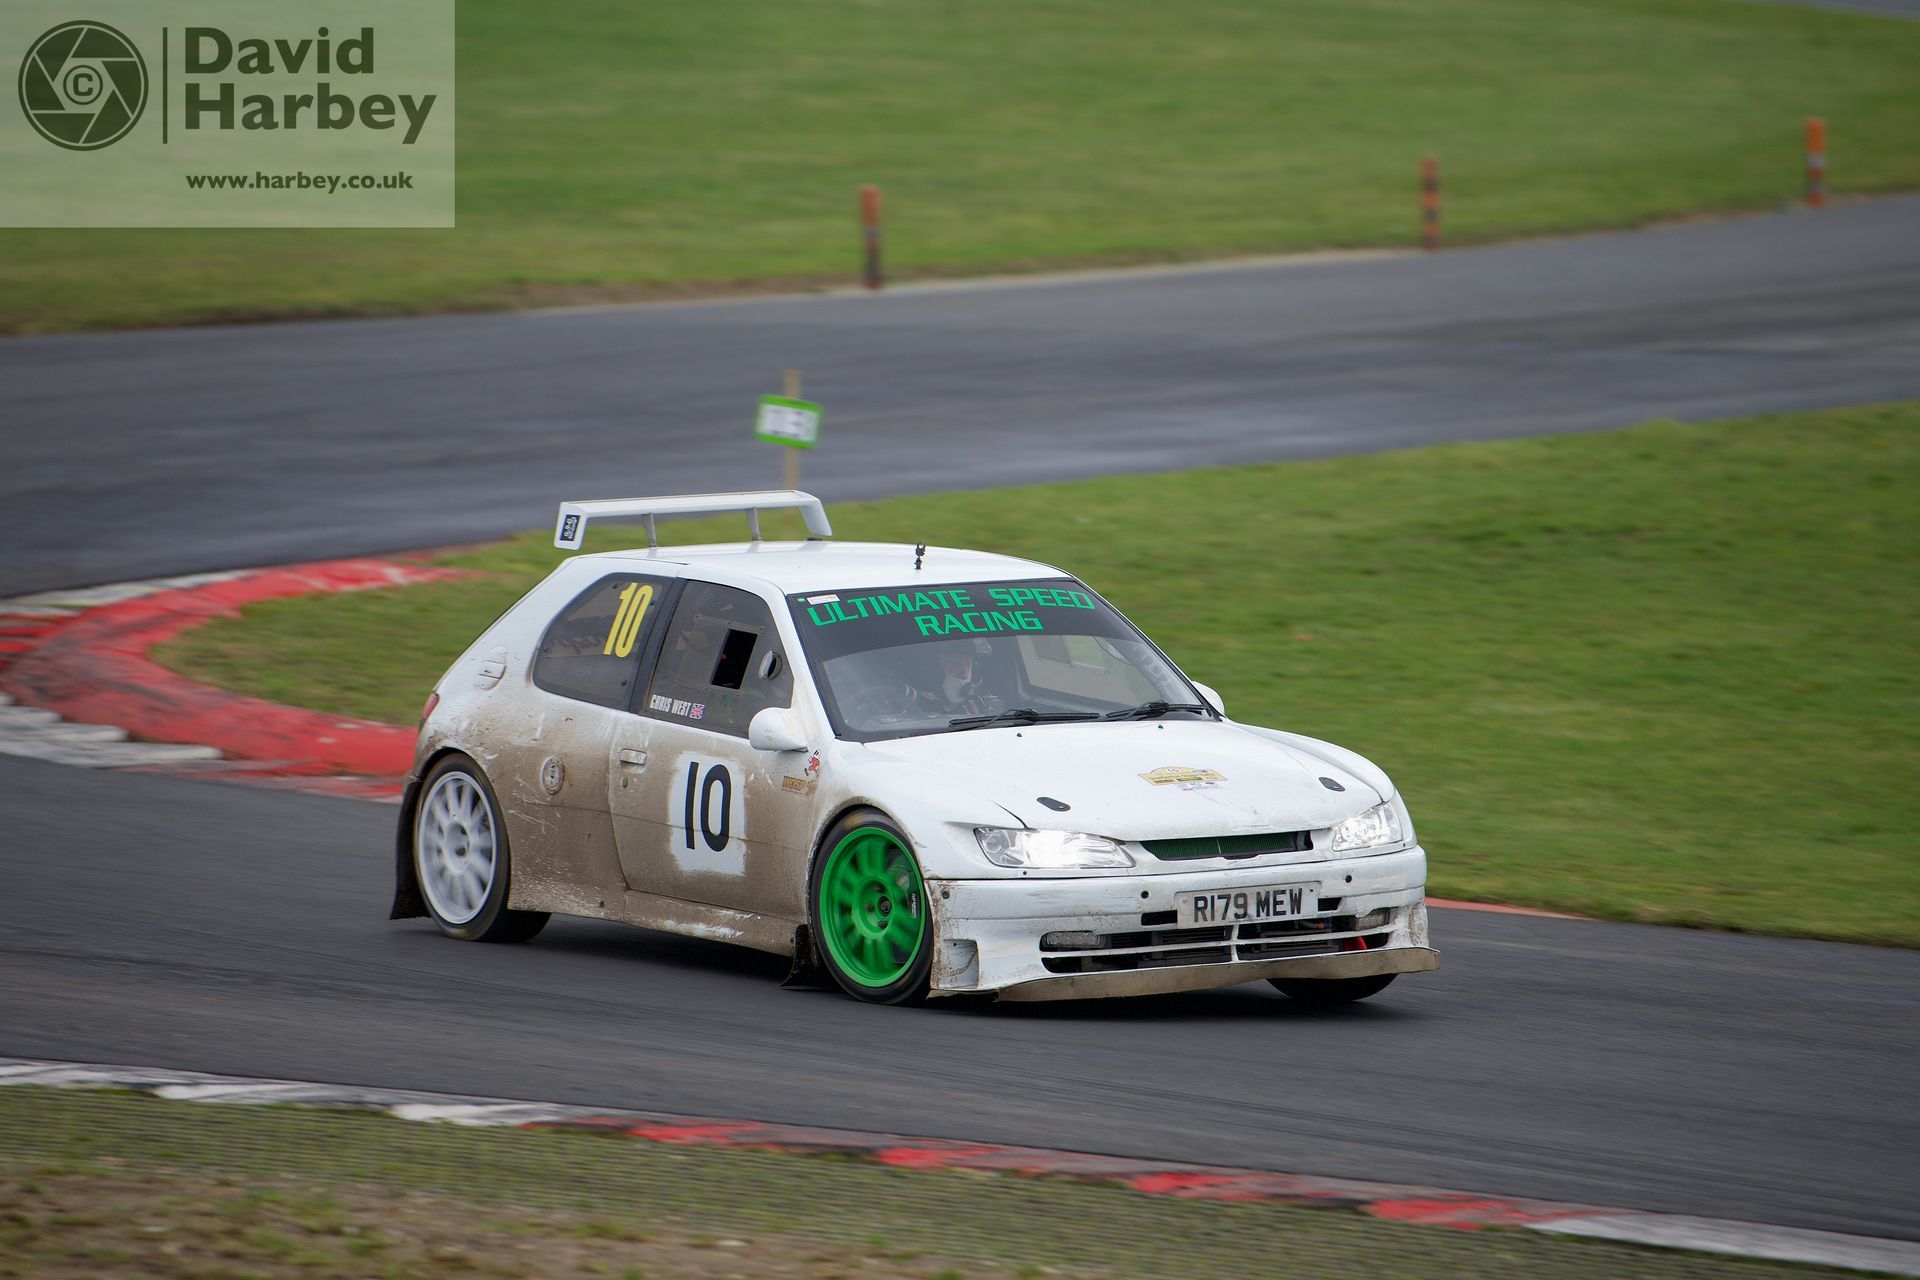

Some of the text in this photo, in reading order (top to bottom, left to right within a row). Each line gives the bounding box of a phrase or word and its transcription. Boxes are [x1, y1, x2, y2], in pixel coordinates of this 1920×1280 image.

[603, 582, 653, 658] 10
[806, 588, 1096, 627] ULTIMATE SPEED
[914, 610, 1044, 637] RACING
[650, 694, 691, 716] CHRIS WEST
[684, 761, 732, 852] 10
[1194, 887, 1303, 923] R179 MEW
